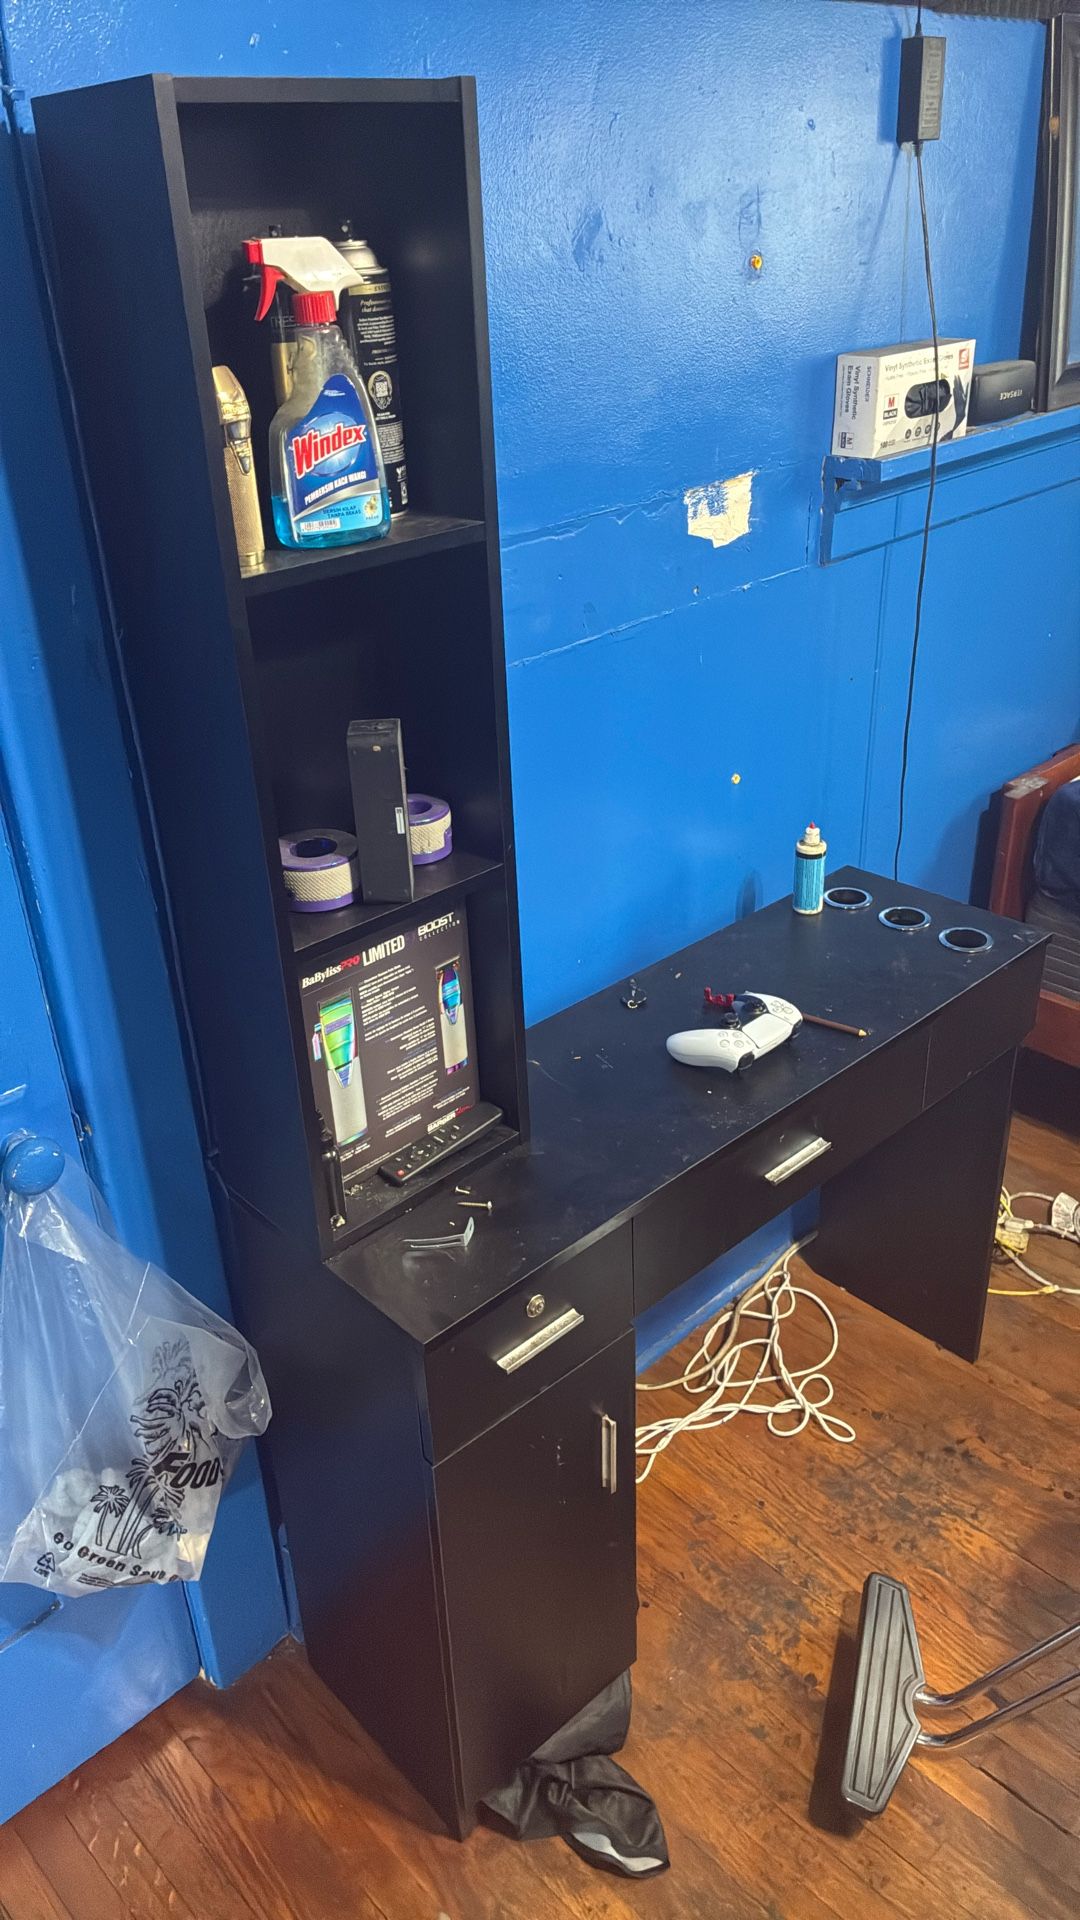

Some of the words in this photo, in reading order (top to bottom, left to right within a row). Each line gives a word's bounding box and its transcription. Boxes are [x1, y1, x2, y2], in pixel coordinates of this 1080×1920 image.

[888, 396, 895, 408] M
[293, 423, 366, 478] Windex
[304, 480, 334, 505] PEMBERSIH
[334, 475, 349, 488] KACA
[417, 912, 454, 937] BOOST
[419, 920, 460, 941] COLLECTION
[362, 935, 405, 967] LIMITED
[53, 1531, 75, 1551] Go
[77, 1546, 126, 1572] Green
